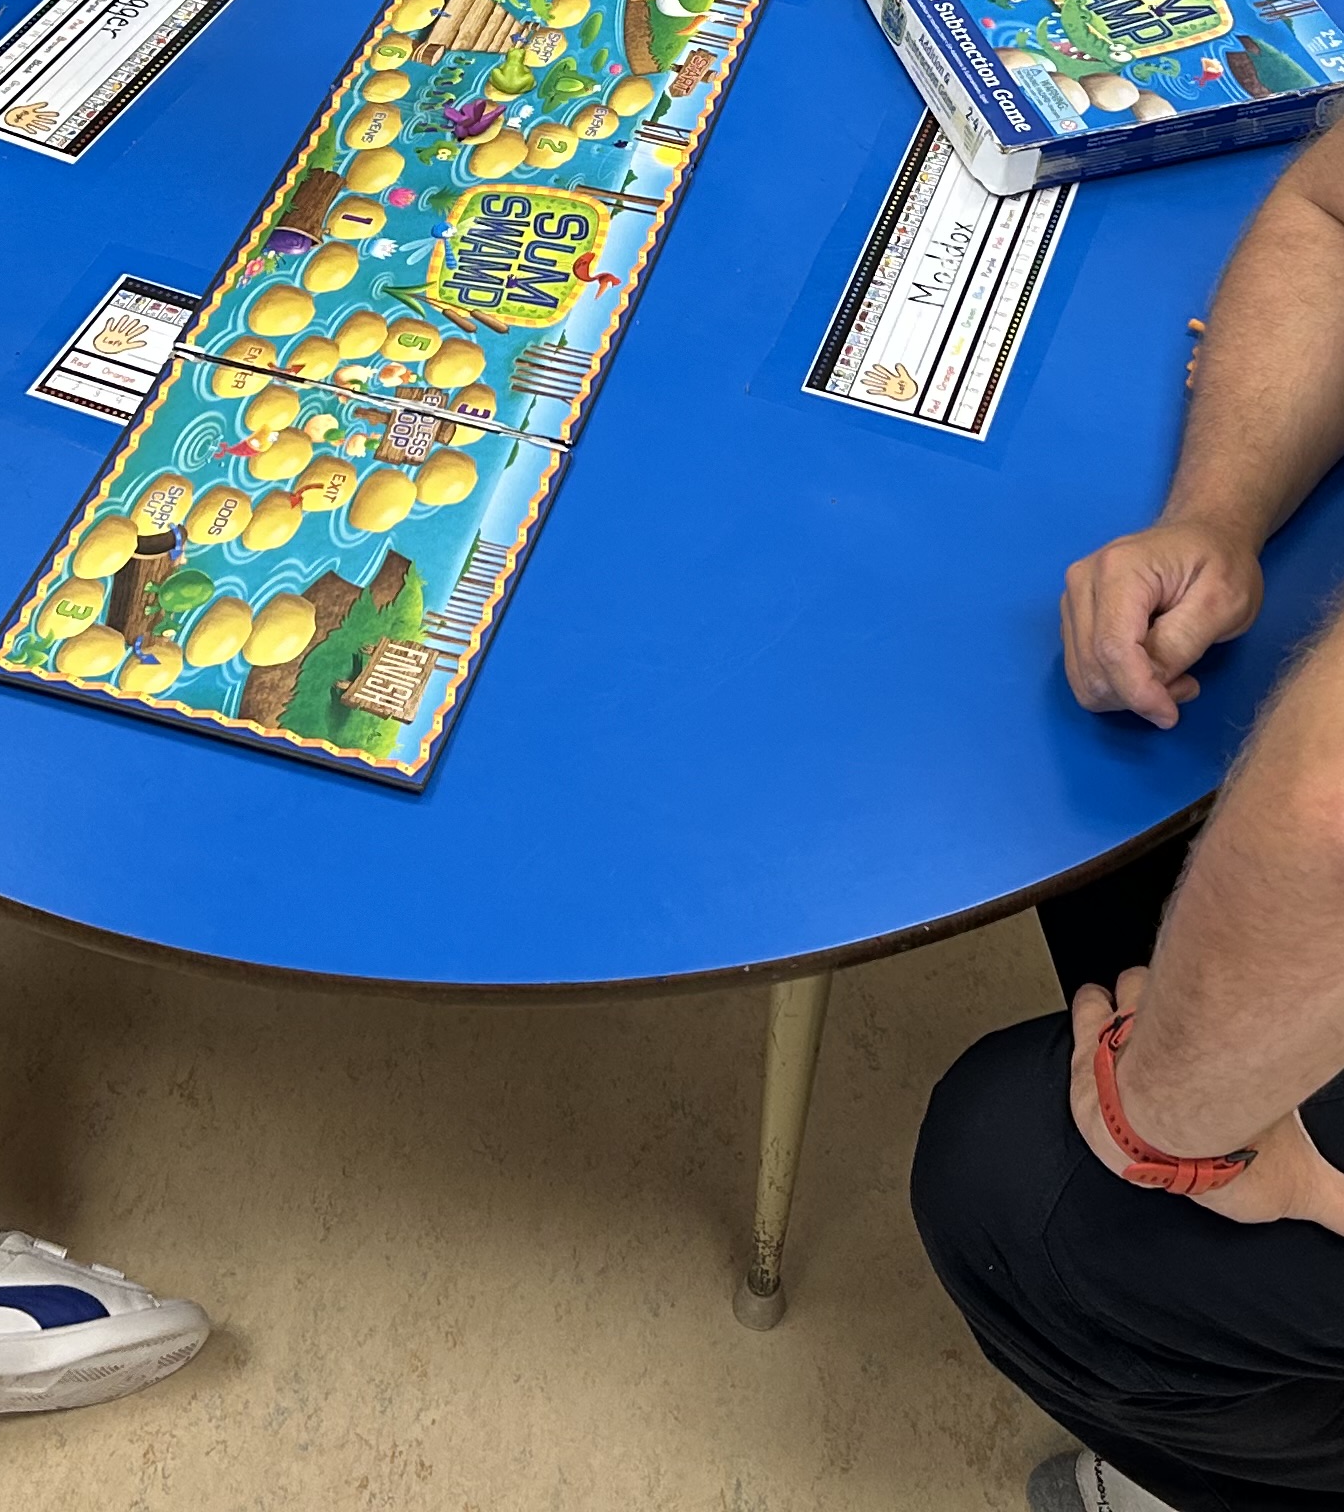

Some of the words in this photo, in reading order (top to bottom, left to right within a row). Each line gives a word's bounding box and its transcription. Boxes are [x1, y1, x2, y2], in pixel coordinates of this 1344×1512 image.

[539, 32, 562, 64] SHORT
[1320, 29, 1343, 48] 2-4
[670, 52, 708, 96] START
[934, 2, 1000, 88] Subtraction
[992, 89, 1032, 133] Game
[361, 112, 387, 144] EVENS
[584, 105, 608, 138] EVENS
[536, 136, 568, 156] 2
[341, 214, 373, 227] 1
[451, 195, 531, 307] SWAMP
[506, 213, 590, 309] SUM
[907, 221, 974, 307] Maddox
[102, 336, 123, 347] Left
[398, 333, 432, 351] 5
[70, 357, 92, 369] Red
[102, 367, 136, 384] Orange
[457, 402, 491, 420] 3
[927, 399, 942, 415] Red
[390, 409, 419, 449] OOP
[323, 472, 349, 504] EXIT
[139, 490, 165, 520] CUT
[152, 485, 185, 531] SHORT
[207, 497, 238, 538] ODDS
[55, 599, 93, 622] 3
[353, 641, 429, 716] FINISH
